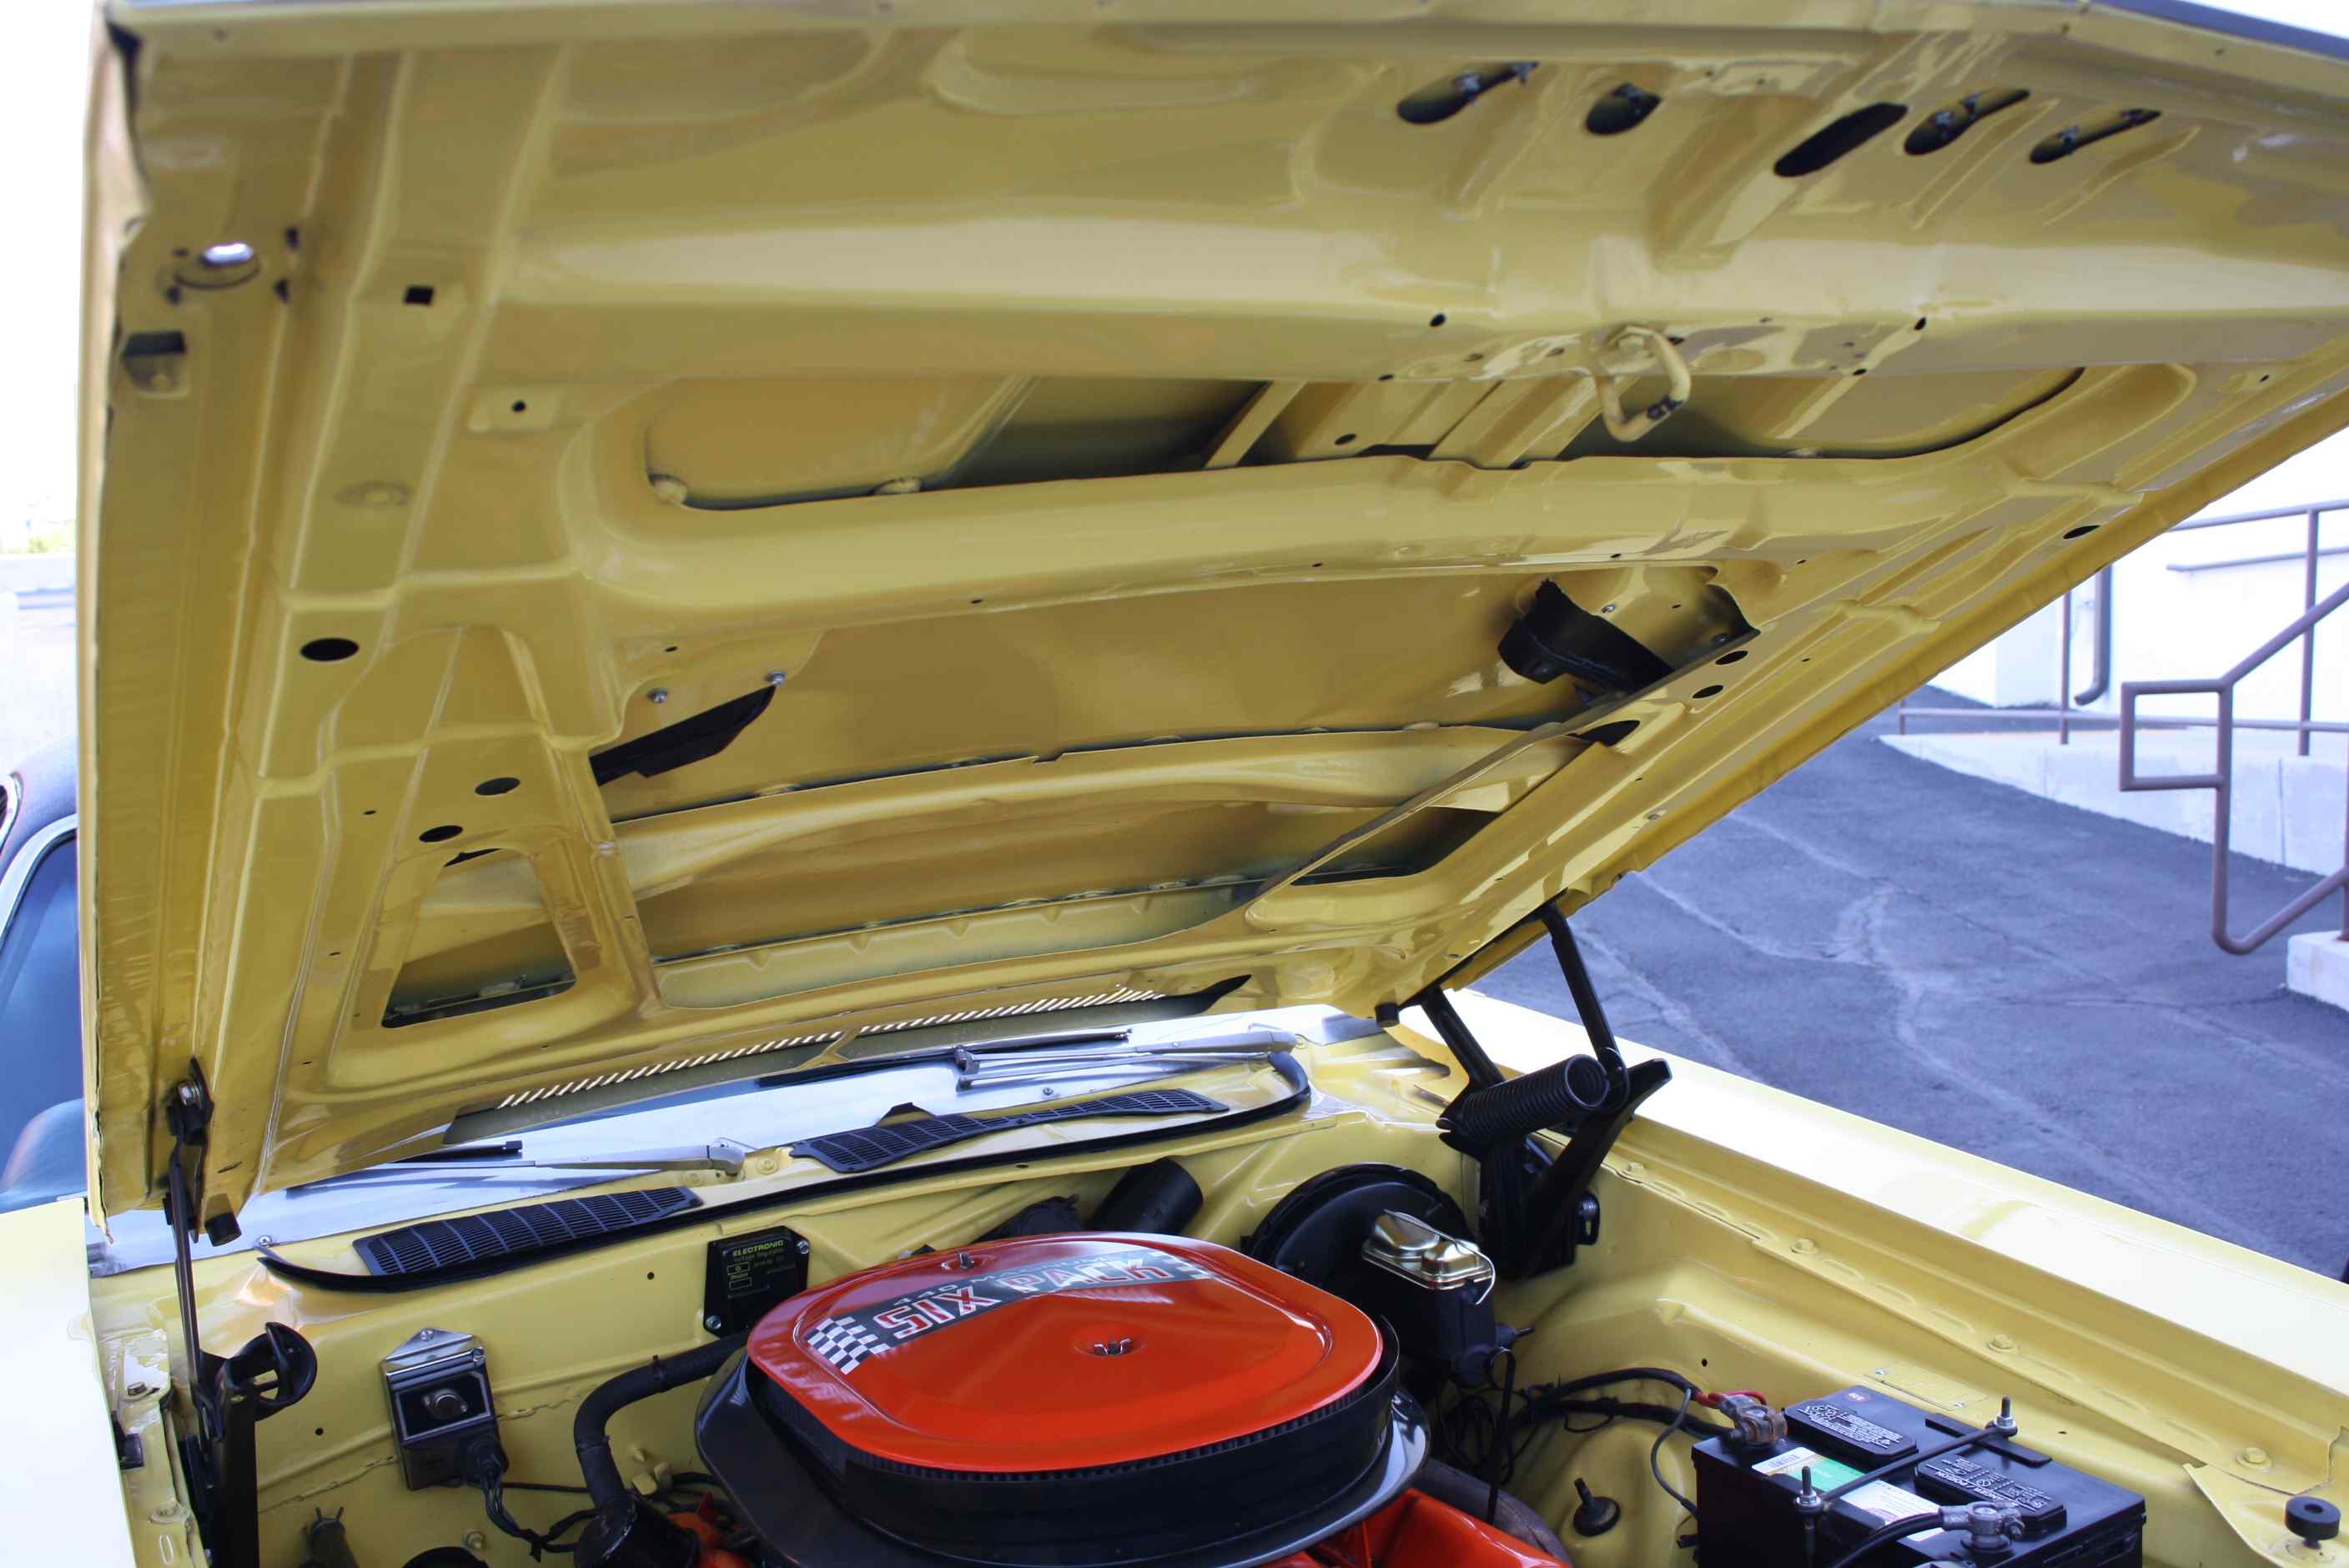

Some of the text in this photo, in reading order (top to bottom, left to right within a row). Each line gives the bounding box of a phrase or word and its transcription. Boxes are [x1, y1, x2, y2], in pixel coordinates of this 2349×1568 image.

[733, 1239, 784, 1256] ELECTRONIC
[873, 1258, 1175, 1339] SIX PACK
[893, 1284, 958, 1306] 440
